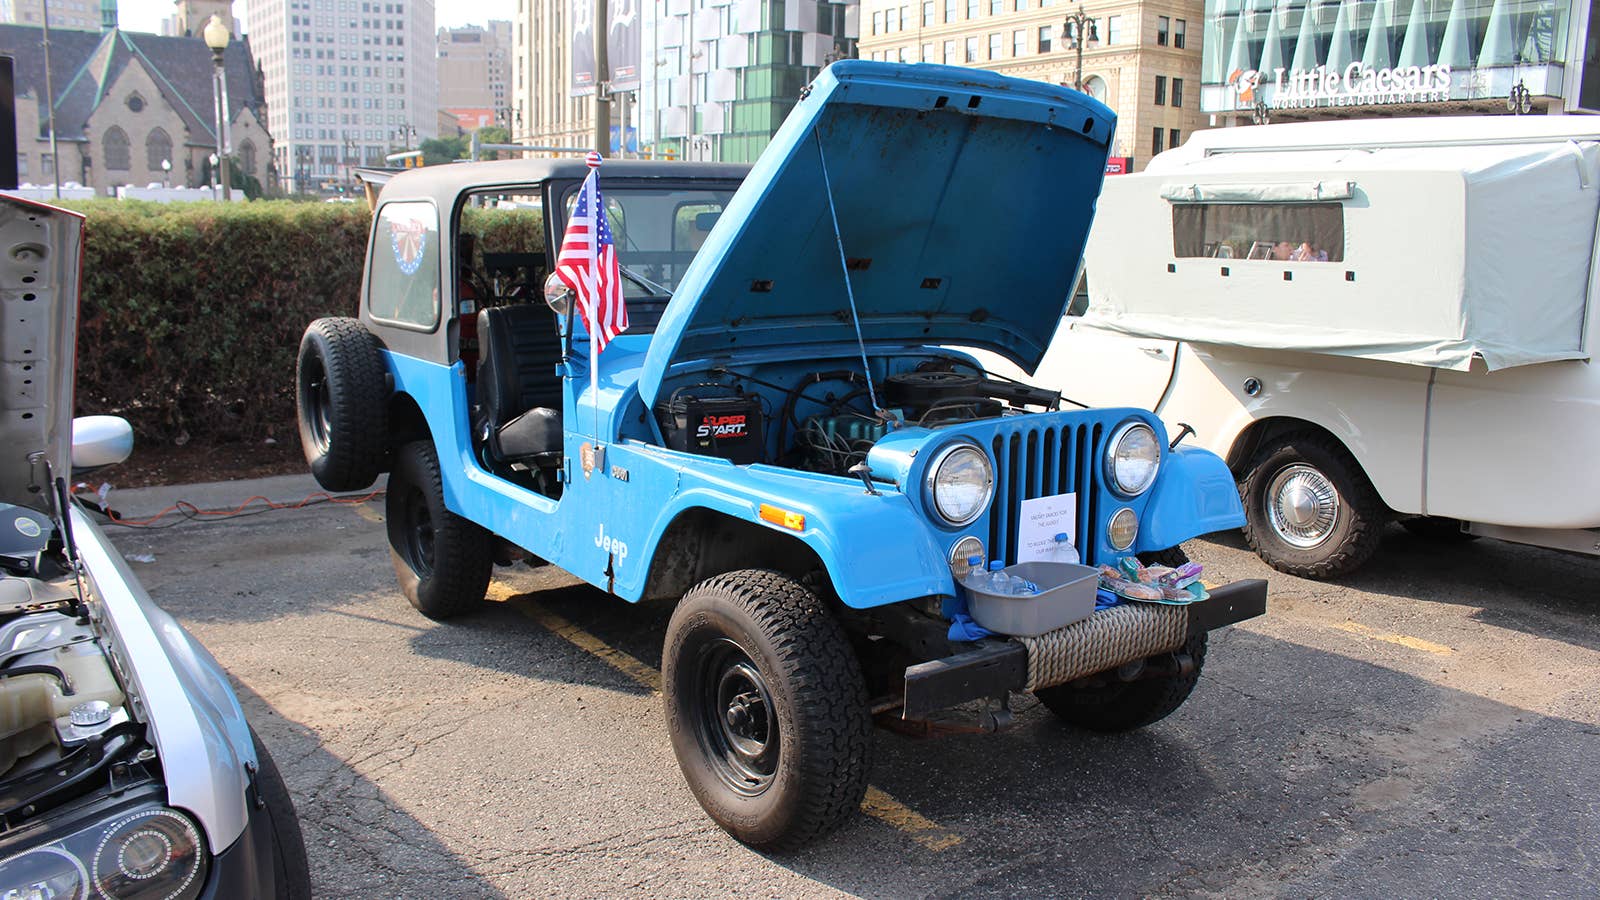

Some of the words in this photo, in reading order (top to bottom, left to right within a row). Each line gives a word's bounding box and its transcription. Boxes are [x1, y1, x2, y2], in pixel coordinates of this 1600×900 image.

[1273, 64, 1340, 97] Little
[1343, 61, 1450, 94] Caesars
[1272, 97, 1317, 110] WORLD
[1328, 90, 1450, 107] HEADQUARTERS
[696, 424, 746, 437] START
[703, 415, 745, 426] SUPER
[594, 523, 628, 567] Jeep
